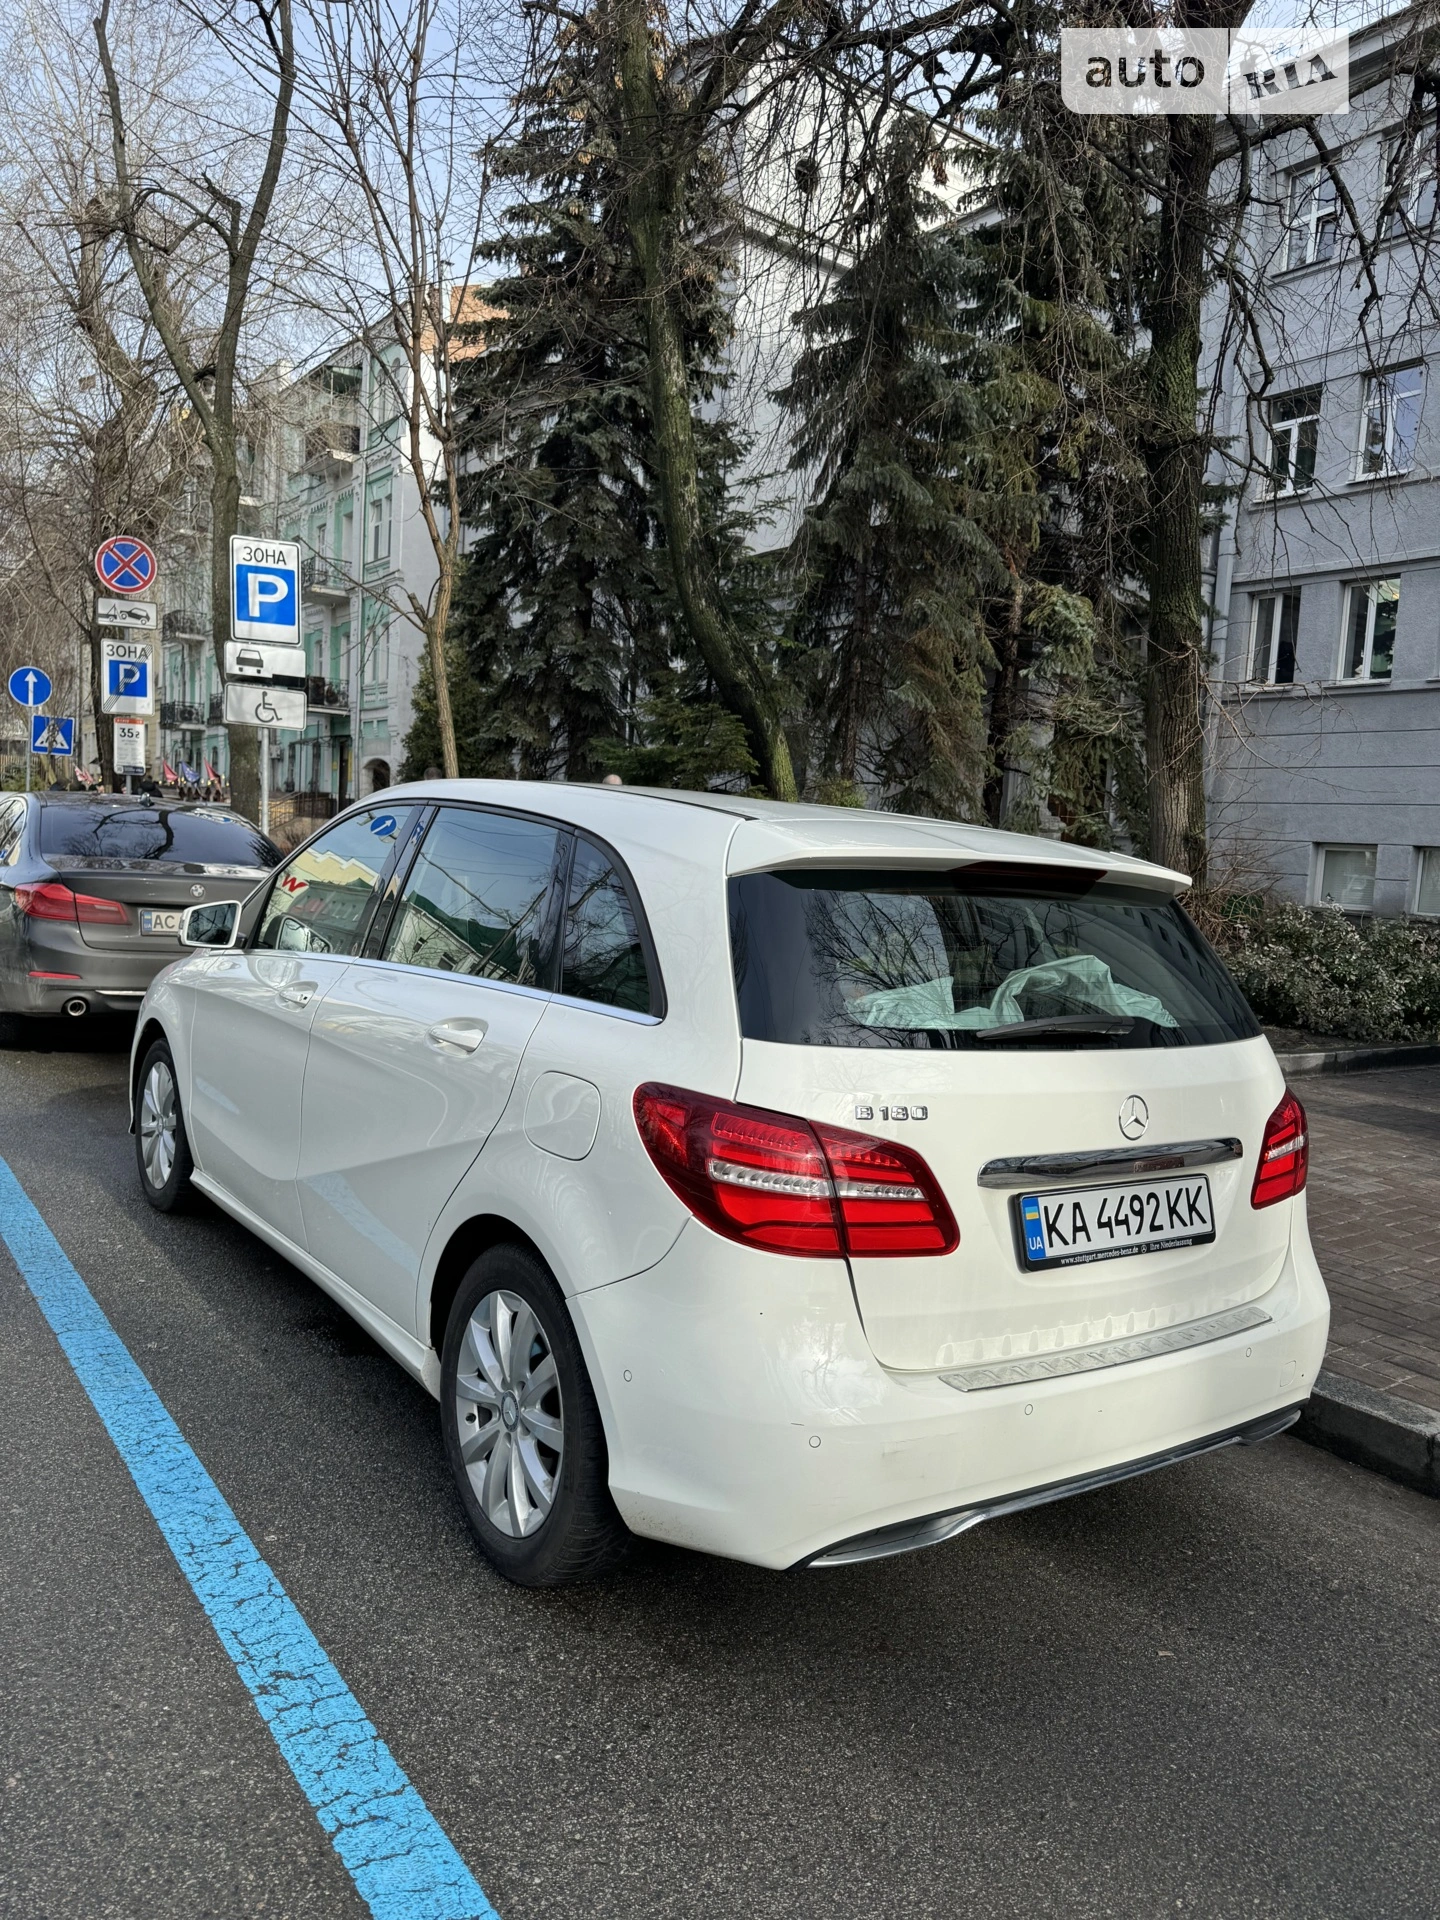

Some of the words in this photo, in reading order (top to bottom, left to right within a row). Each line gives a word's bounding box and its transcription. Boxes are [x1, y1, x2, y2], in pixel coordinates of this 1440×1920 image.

[242, 546, 287, 566] ЗОНА
[247, 572, 289, 617] P
[106, 644, 149, 660] ЗОНА
[153, 914, 175, 930] AC
[855, 1105, 874, 1121] B
[879, 1105, 929, 1121] 180
[1043, 1202, 1092, 1249] KA
[1096, 1192, 1164, 1239] 4492
[1165, 1185, 1207, 1230] KK
[1029, 1239, 1044, 1250] UA
[1060, 1246, 1139, 1265] www.stuttgart.mercedes-benz.de
[1149, 1243, 1160, 1251] Ihre
